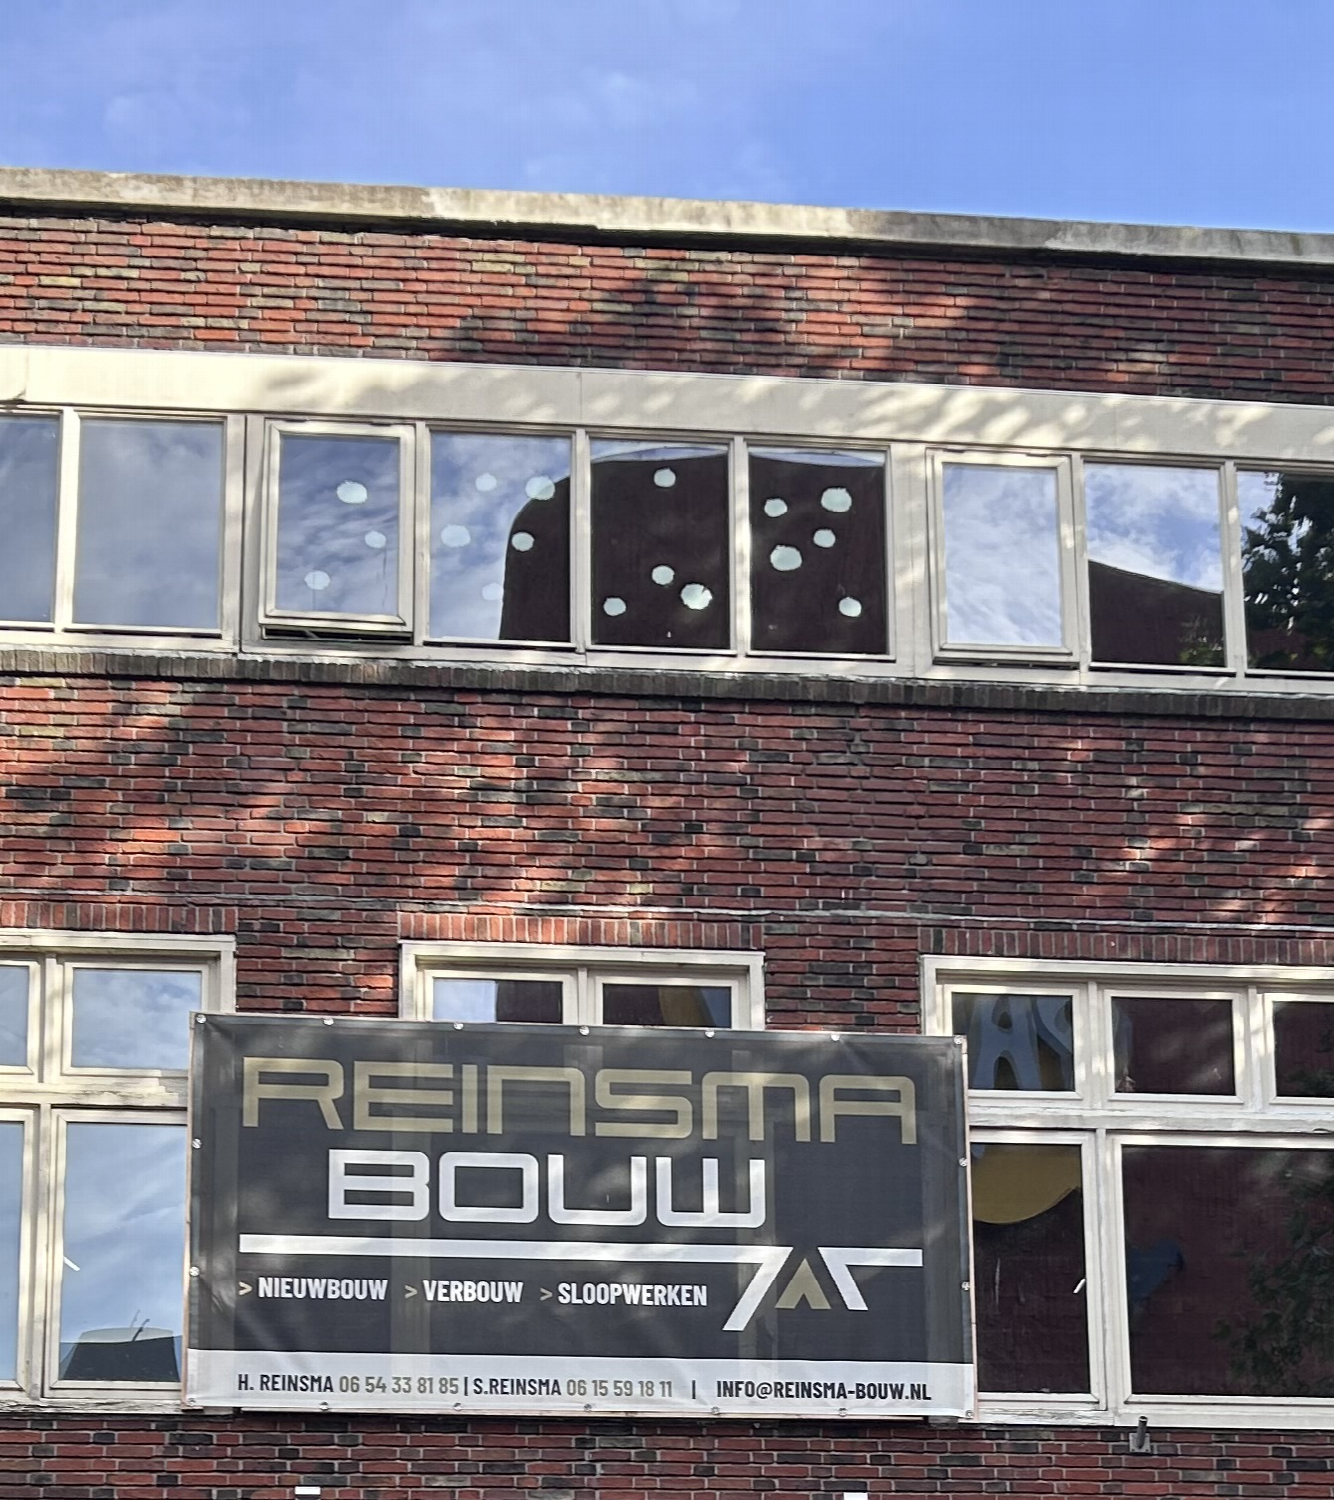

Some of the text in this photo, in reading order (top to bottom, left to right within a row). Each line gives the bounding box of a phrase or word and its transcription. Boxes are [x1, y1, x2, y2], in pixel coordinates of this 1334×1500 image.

[241, 1055, 917, 1145] REINSMA
[328, 1148, 766, 1228] BOUW
[258, 1277, 708, 1307] NIEUWBOUW VERBOUW SLOOPWERKEN
[237, 1374, 932, 1400] H. REINSMA 06 54 33 81 85 S.REINSMA 06 15 59 18 11 INFO@REINSMA-BOUW.NL
